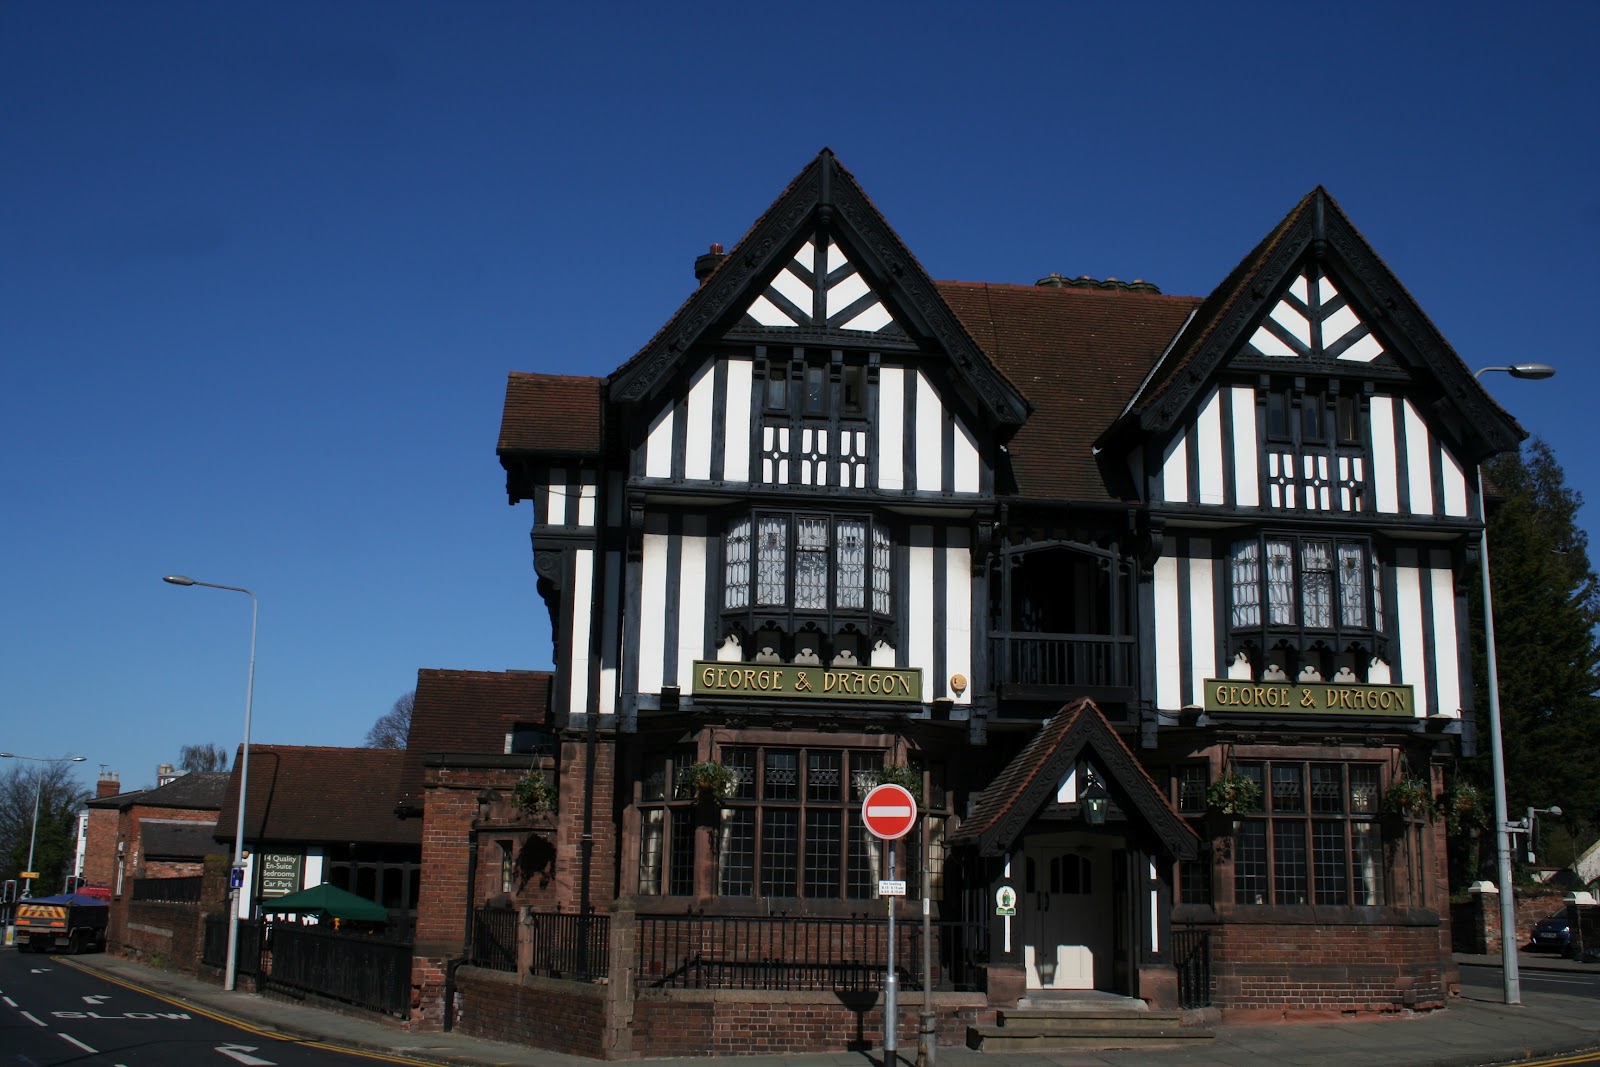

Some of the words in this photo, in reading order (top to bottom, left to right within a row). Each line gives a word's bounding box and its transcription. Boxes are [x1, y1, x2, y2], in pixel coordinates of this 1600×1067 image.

[702, 667, 783, 690] GEORGE
[794, 671, 812, 691] &
[823, 671, 911, 694] DRAGON
[1216, 685, 1290, 707] GEORGE
[1300, 688, 1316, 708] &
[1326, 688, 1405, 710] DRAGON
[272, 855, 296, 864] Quality
[51, 1011, 192, 1020] SLOW
